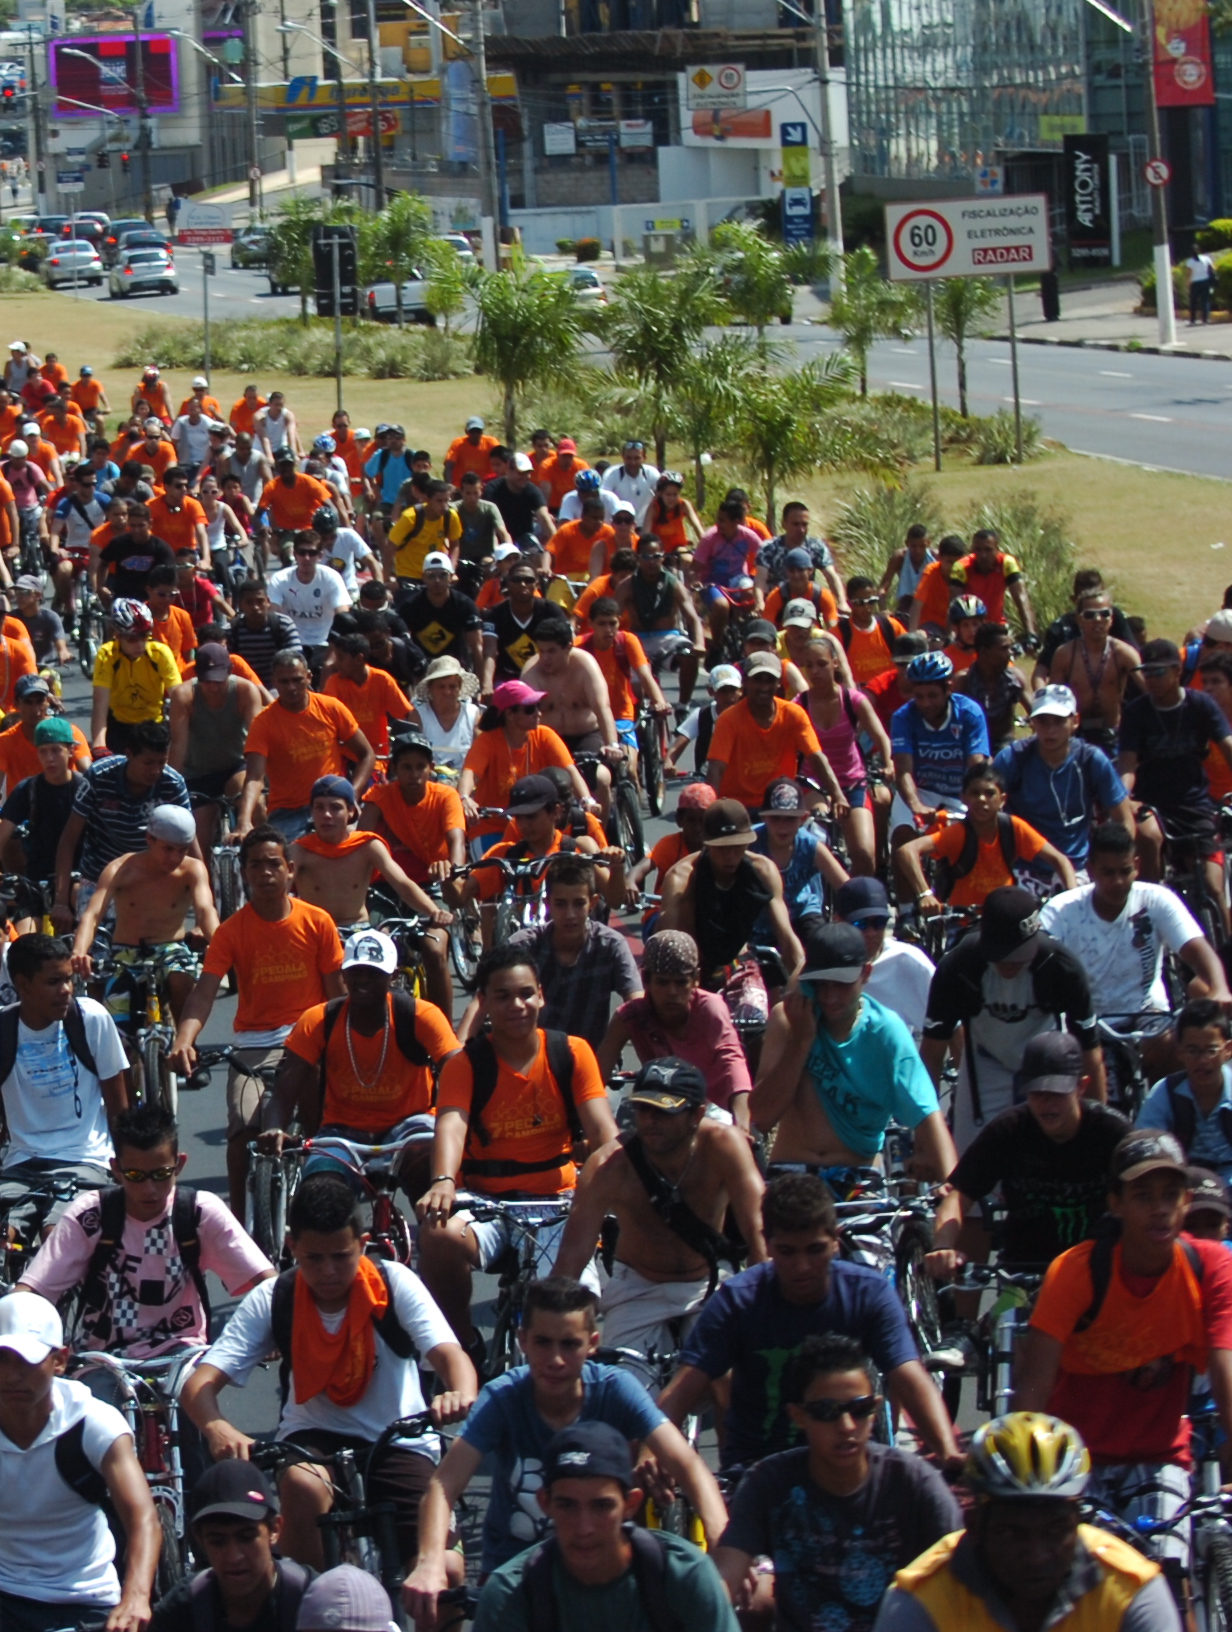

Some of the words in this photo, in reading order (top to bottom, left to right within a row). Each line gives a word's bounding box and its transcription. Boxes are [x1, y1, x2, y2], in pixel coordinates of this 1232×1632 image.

[1074, 150, 1094, 227] ANTONY
[961, 205, 1039, 220] FISCALIZAÇÃO
[910, 224, 937, 248] 60
[967, 226, 1035, 240] ELETRÔNICA
[973, 248, 1031, 265] RADAR
[261, 961, 306, 976] PEDALA
[490, 1121, 503, 1139] 7
